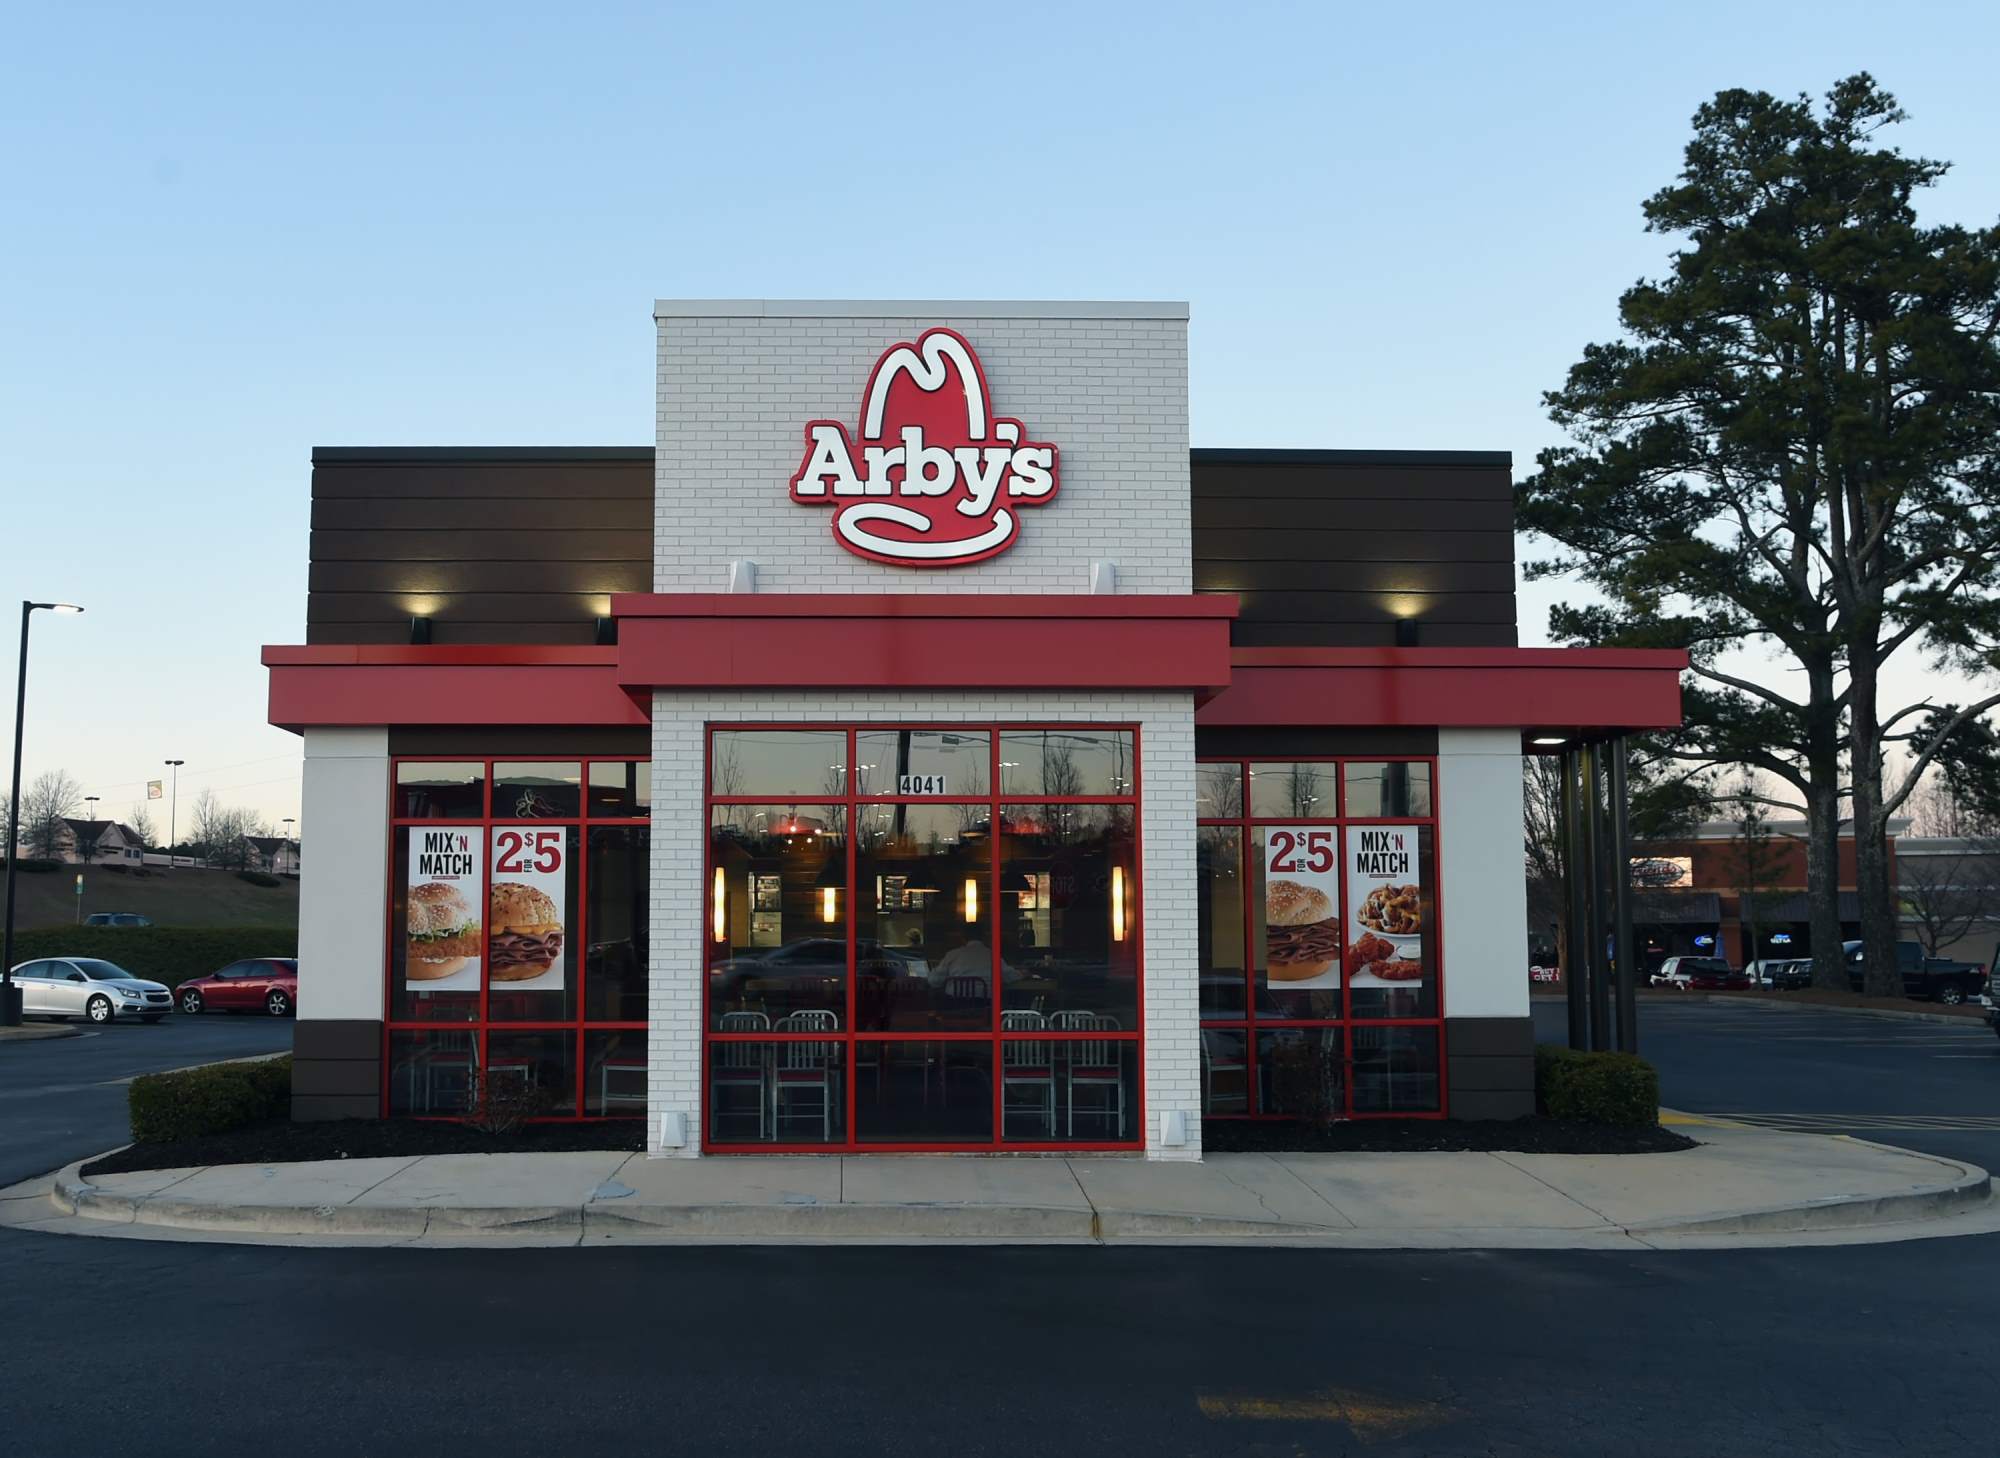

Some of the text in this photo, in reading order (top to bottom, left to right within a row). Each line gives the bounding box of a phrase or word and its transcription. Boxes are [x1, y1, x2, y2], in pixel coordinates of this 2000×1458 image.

[797, 423, 1053, 516] Arby's
[901, 776, 944, 794] 4041
[425, 832, 454, 853] MIX
[1361, 831, 1390, 852] MIX
[420, 854, 473, 875] MATCH
[523, 859, 533, 873] FOR
[1296, 858, 1306, 873] FOR
[1357, 853, 1409, 873] MATCH
